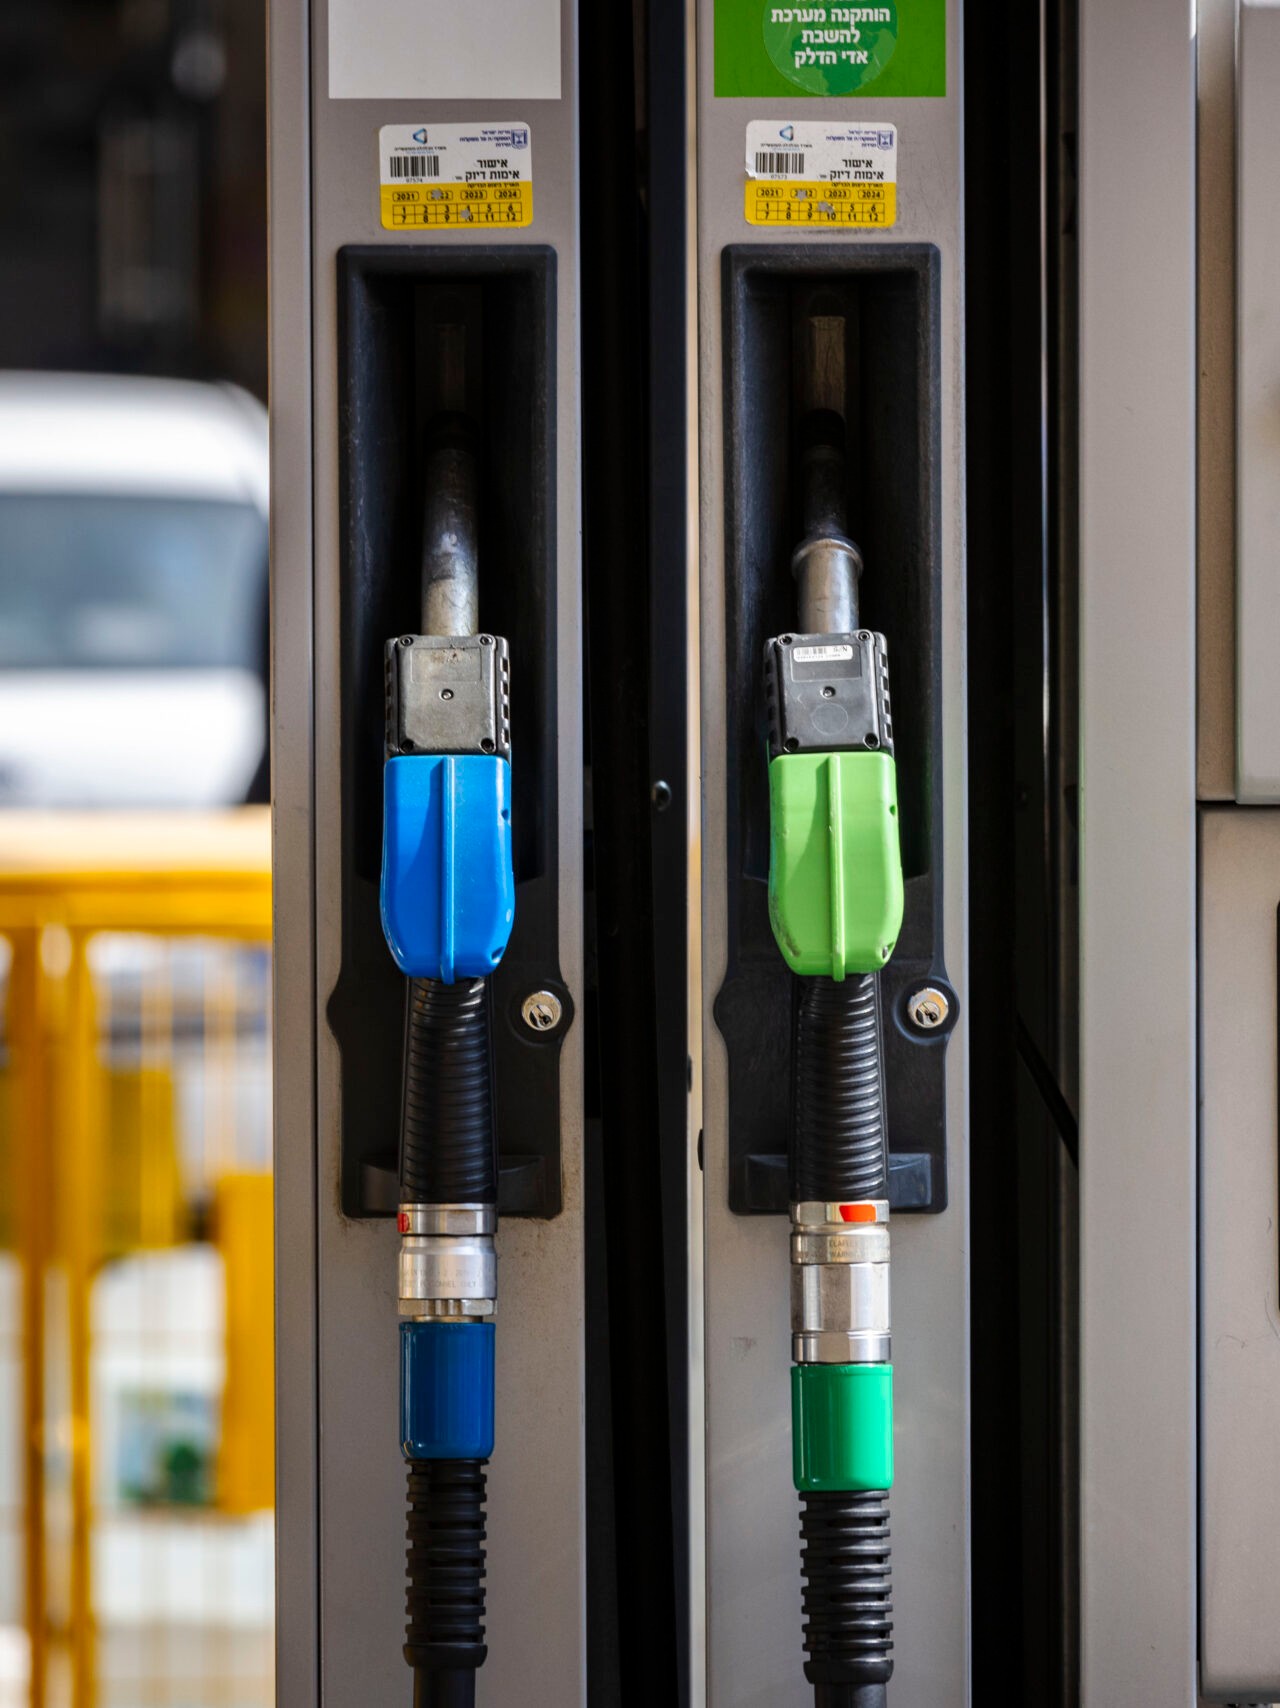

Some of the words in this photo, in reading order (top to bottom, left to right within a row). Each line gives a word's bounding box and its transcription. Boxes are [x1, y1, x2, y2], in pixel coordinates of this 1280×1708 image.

[771, 8, 825, 23] מערכת
[831, 7, 890, 27] הותקנה
[801, 26, 861, 44] להשבת
[795, 47, 837, 68] הדלק
[842, 50, 868, 64] אדי
[477, 159, 508, 168] אישור
[842, 159, 873, 168] אישור
[465, 171, 486, 182] דיוק
[490, 170, 520, 179] אימות
[830, 170, 850, 181] דיוק
[854, 170, 884, 180] אימות
[498, 190, 517, 198] 2024
[828, 190, 847, 198] 2023
